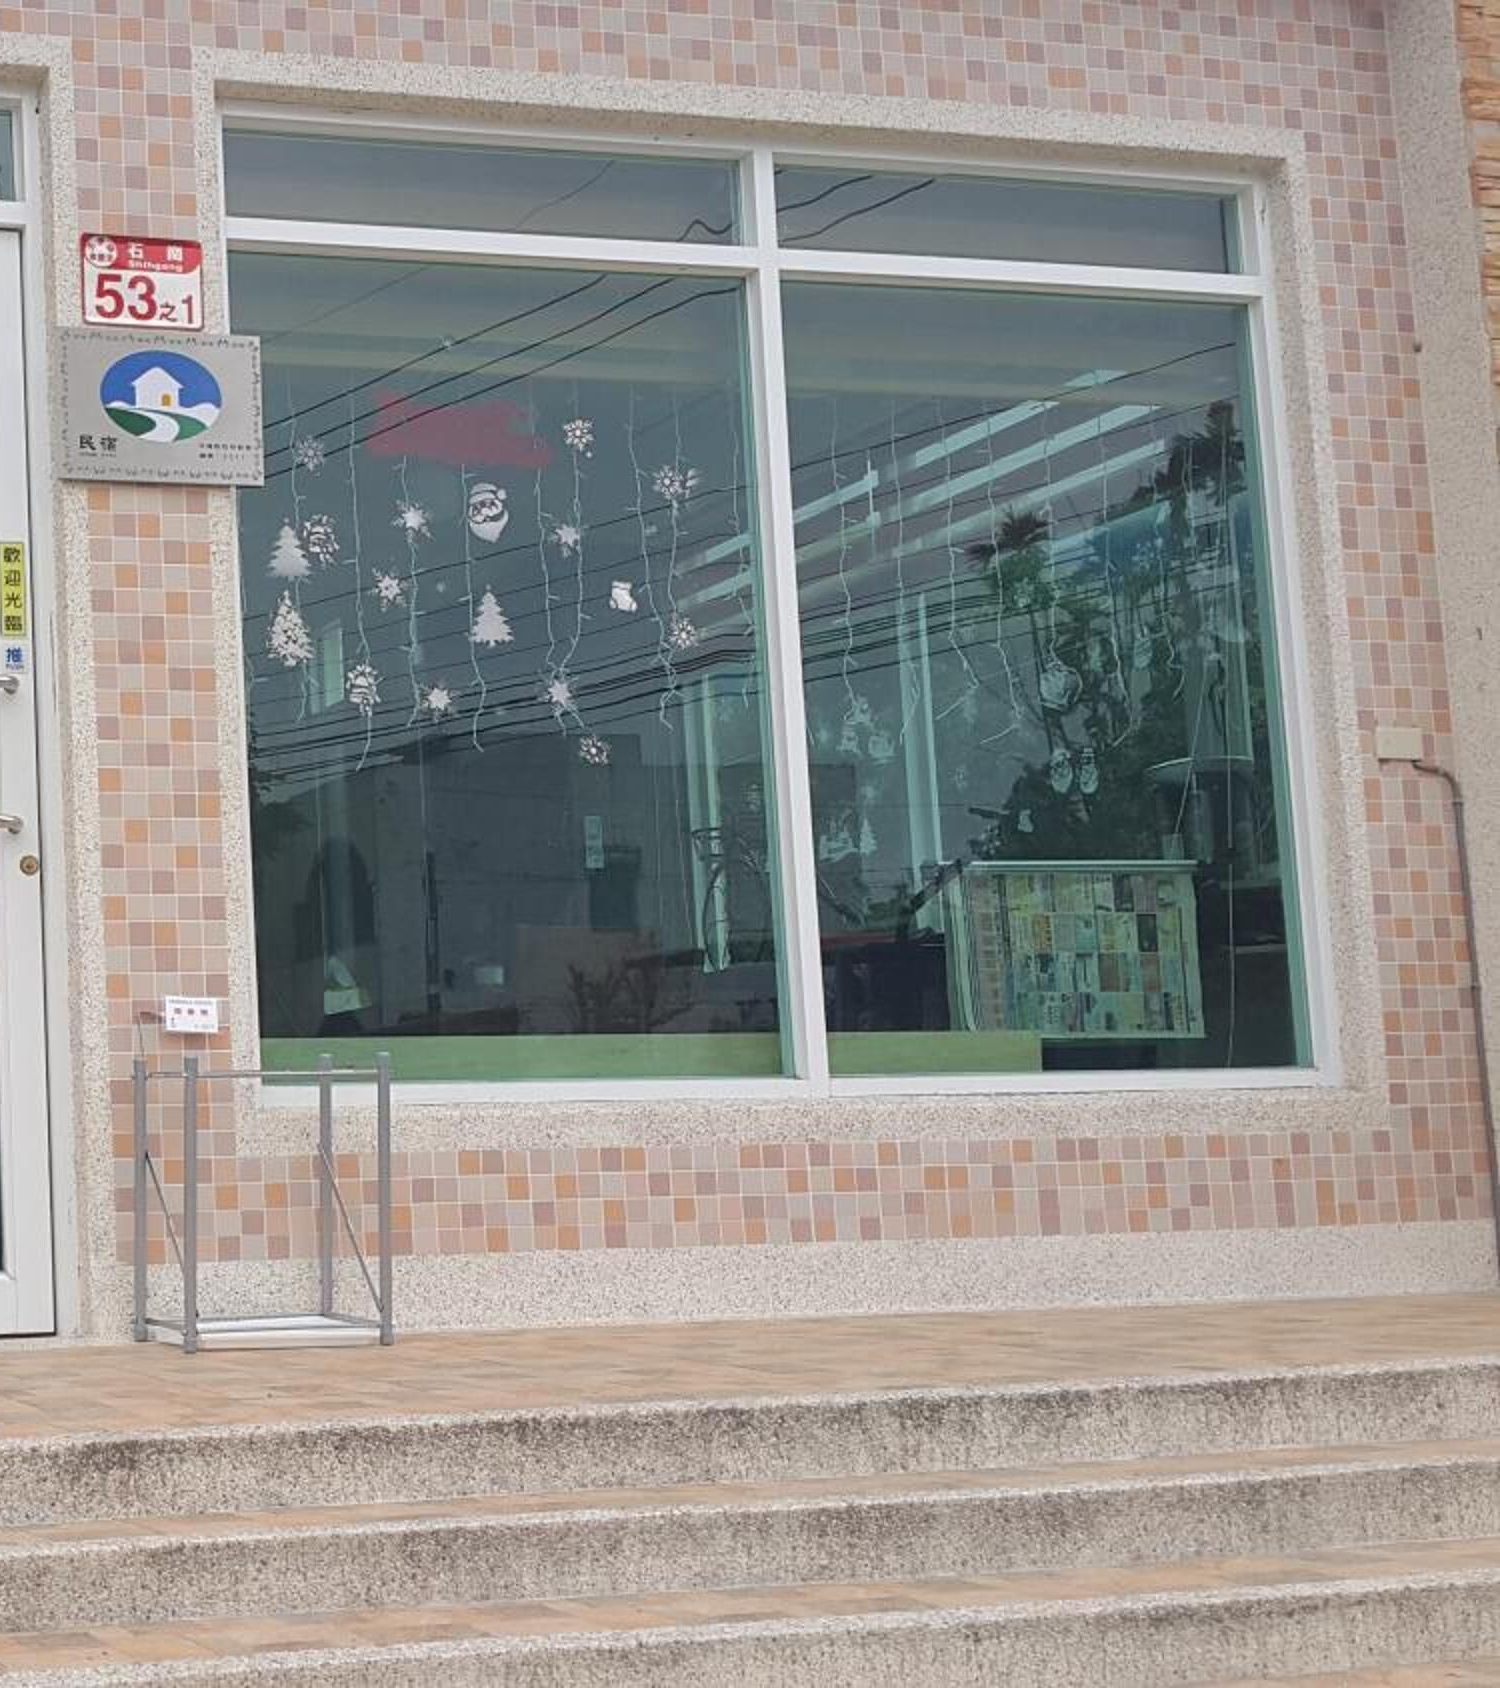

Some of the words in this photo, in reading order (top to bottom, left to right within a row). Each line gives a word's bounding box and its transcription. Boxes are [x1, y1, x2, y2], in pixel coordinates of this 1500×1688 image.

[95, 273, 194, 325] 53之1
[79, 435, 117, 452] 民宿
[3, 546, 22, 632] 歡迎光臨
